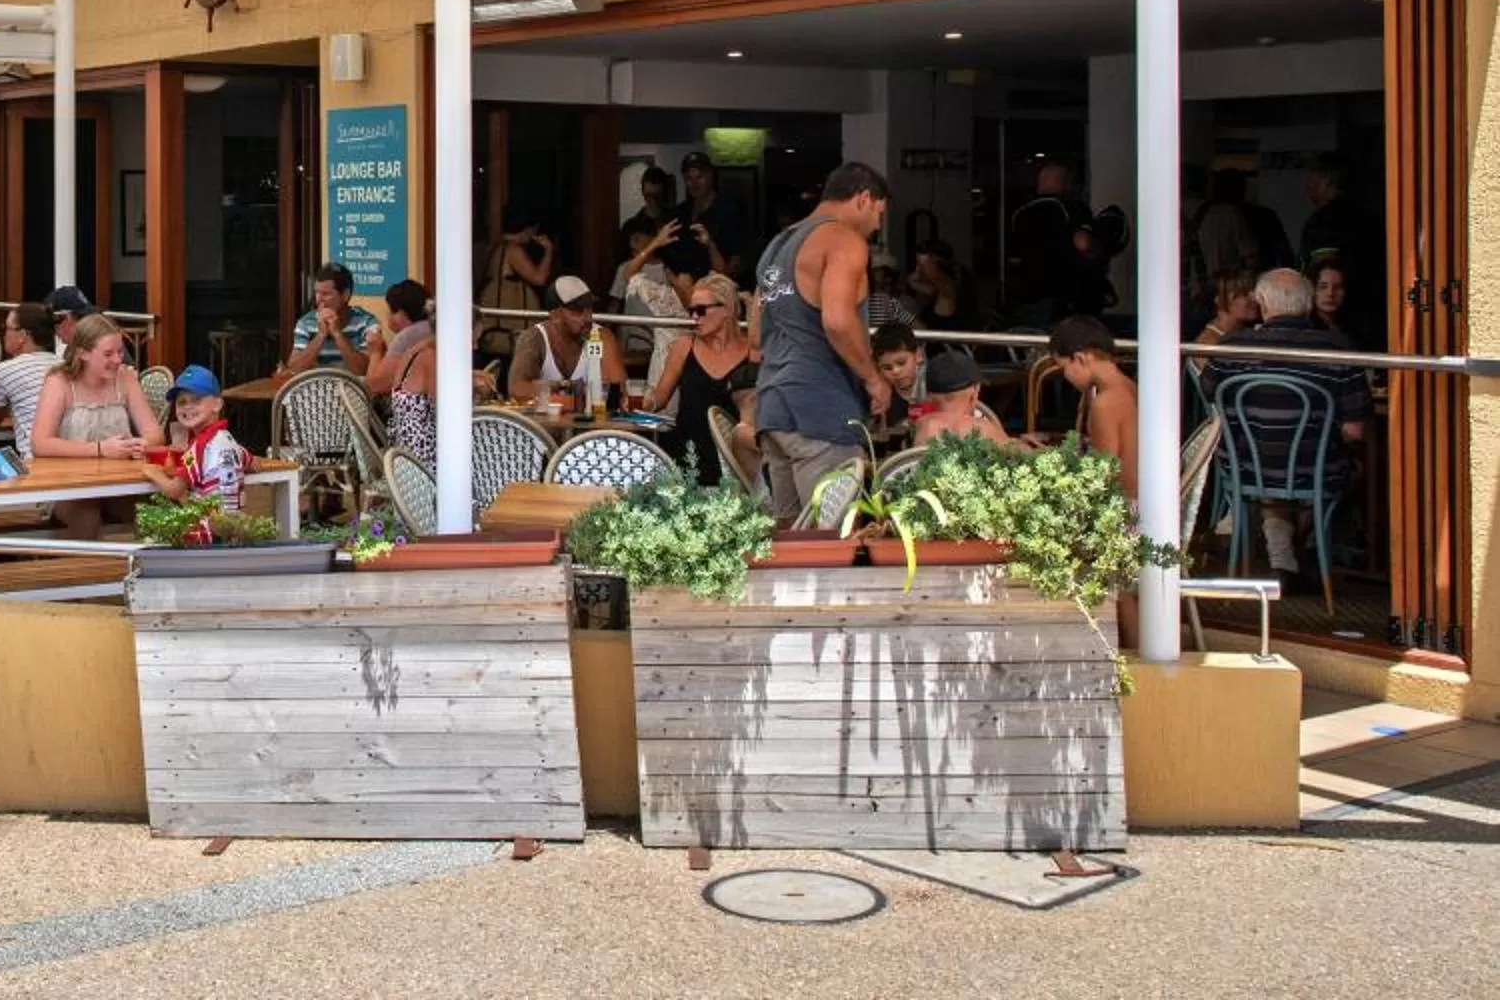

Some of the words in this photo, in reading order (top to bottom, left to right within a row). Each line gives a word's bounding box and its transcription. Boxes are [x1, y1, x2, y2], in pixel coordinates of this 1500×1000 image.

[331, 162, 375, 180] LOUNGE
[377, 160, 402, 179] BAR
[337, 185, 396, 204] ENTRANCE
